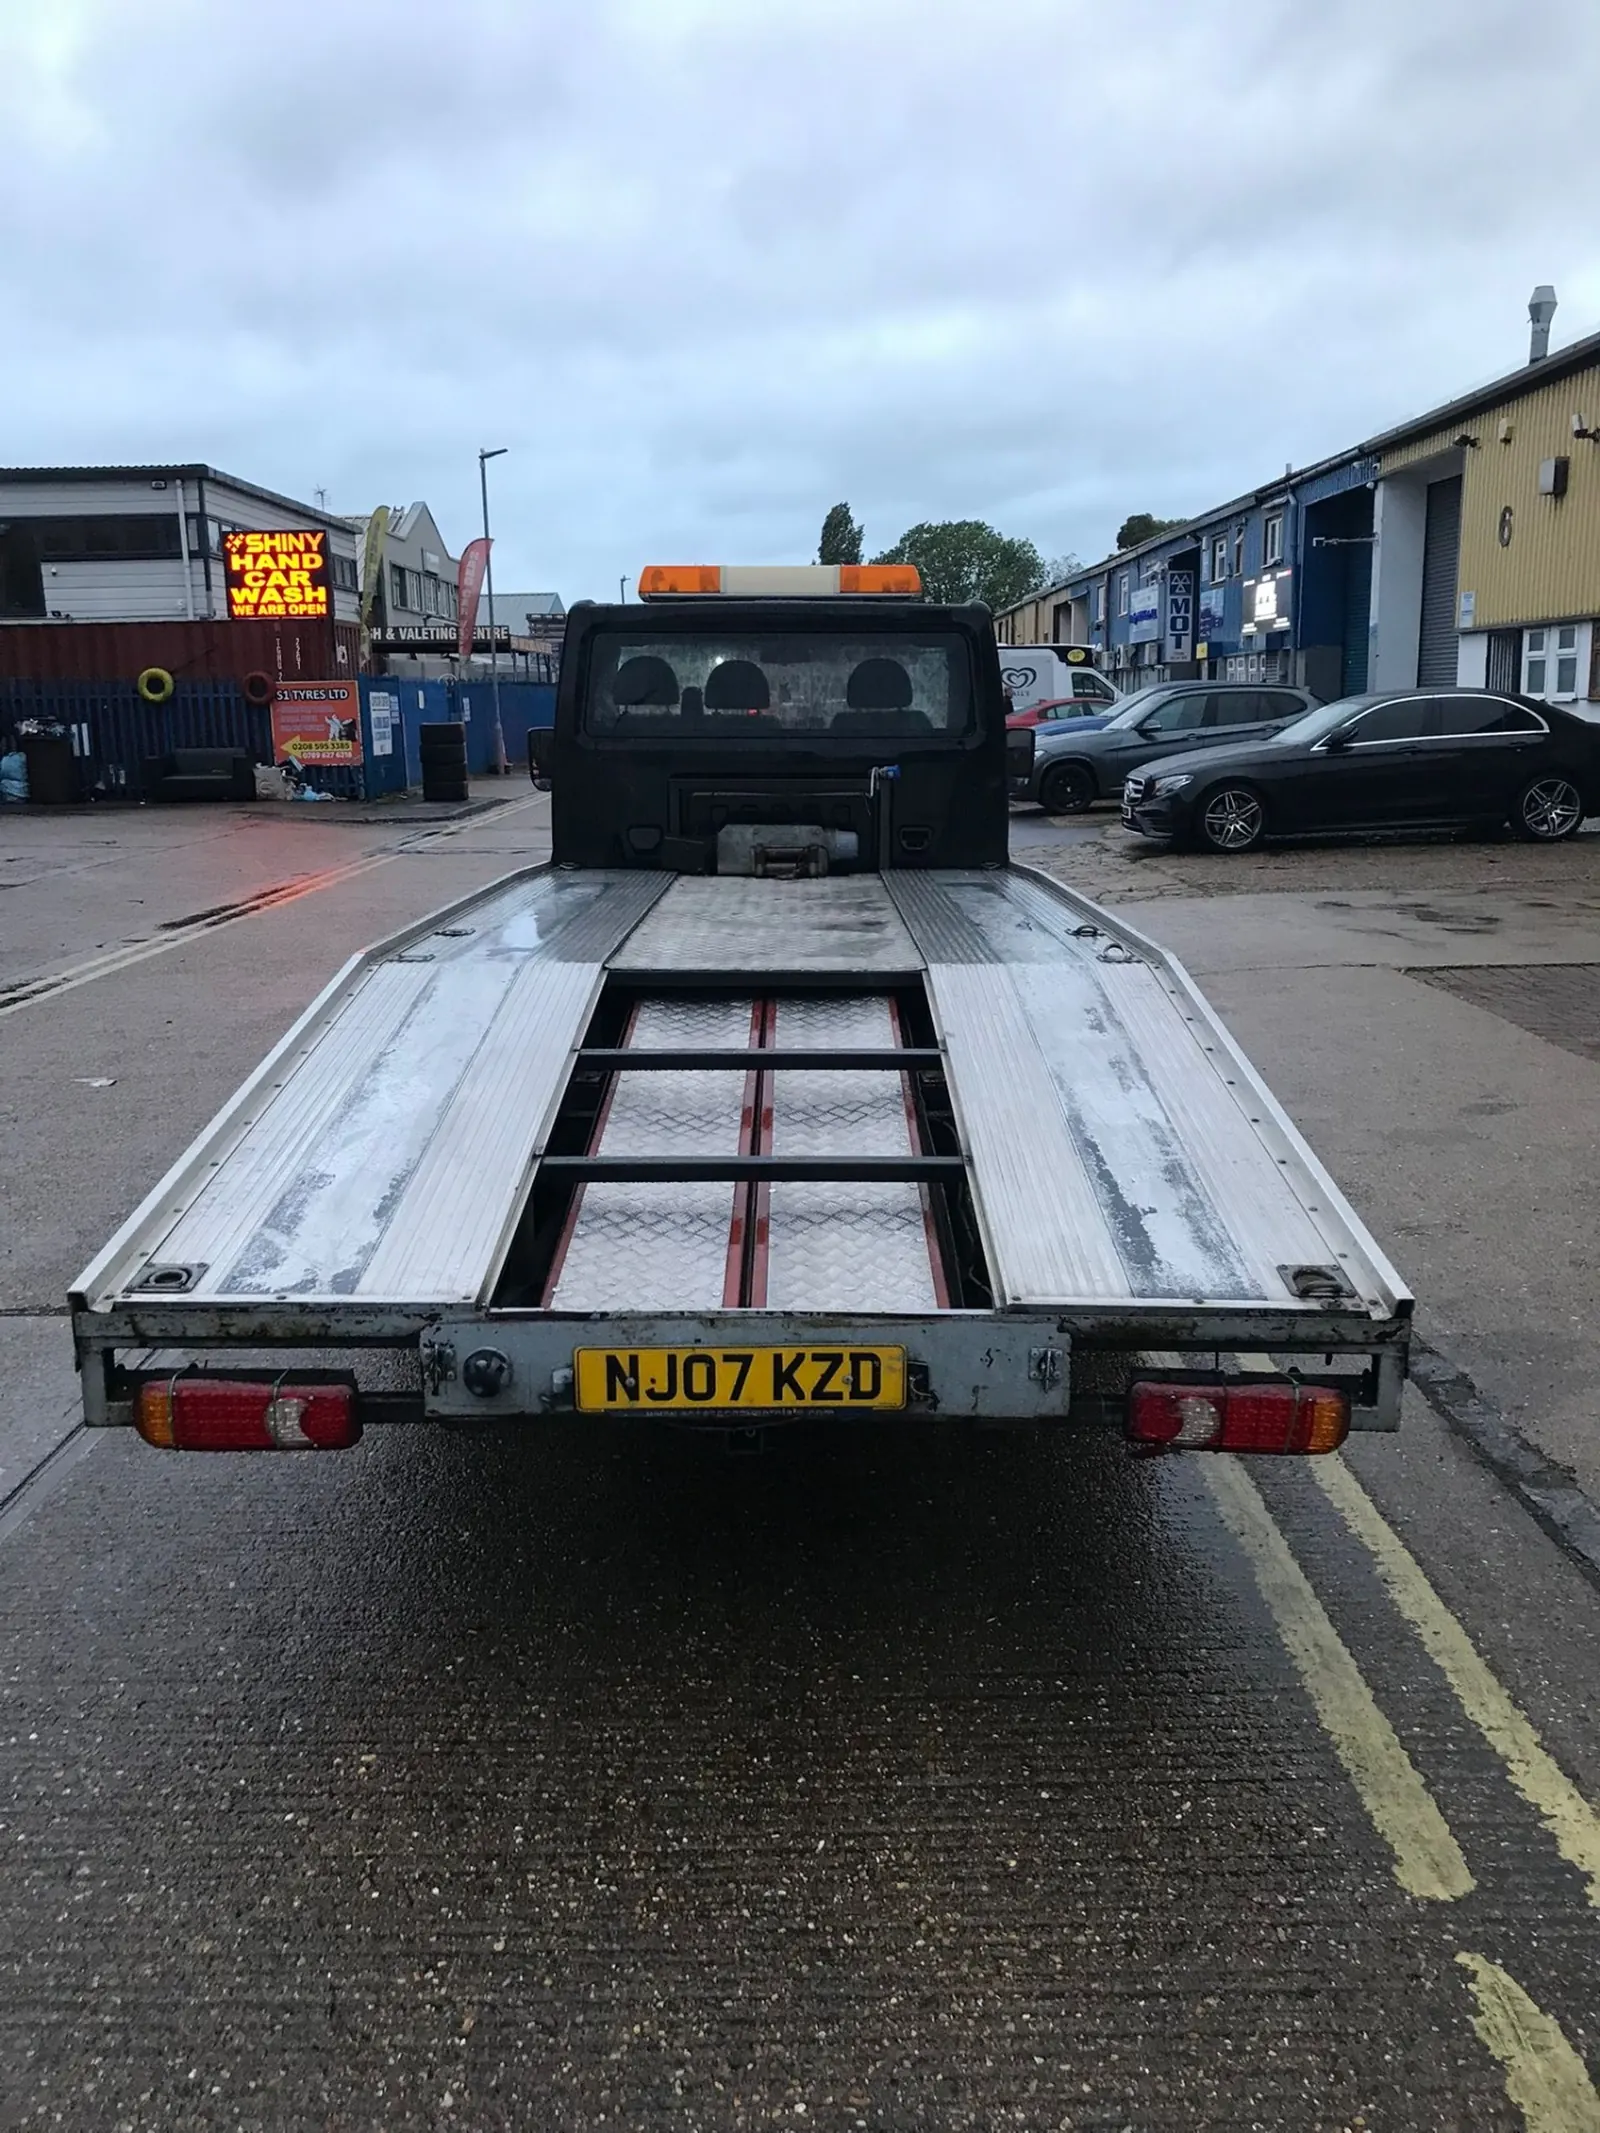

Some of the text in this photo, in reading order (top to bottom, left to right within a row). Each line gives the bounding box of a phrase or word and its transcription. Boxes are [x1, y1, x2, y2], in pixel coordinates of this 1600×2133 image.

[1499, 506, 1513, 548] 6
[245, 533, 323, 553] SHINY
[230, 553, 323, 570] HAND
[244, 570, 311, 587] CAR
[230, 586, 327, 603] WASH
[232, 603, 327, 616] WE ARE OPEN
[1169, 597, 1191, 649] MOT
[386, 627, 396, 640] &
[399, 627, 457, 640] VALETING
[472, 626, 509, 640] ENTRE
[276, 689, 348, 701] S1 TYRES LTD
[292, 742, 313, 751] 0208
[606, 1351, 881, 1402] NJ07 KZD
